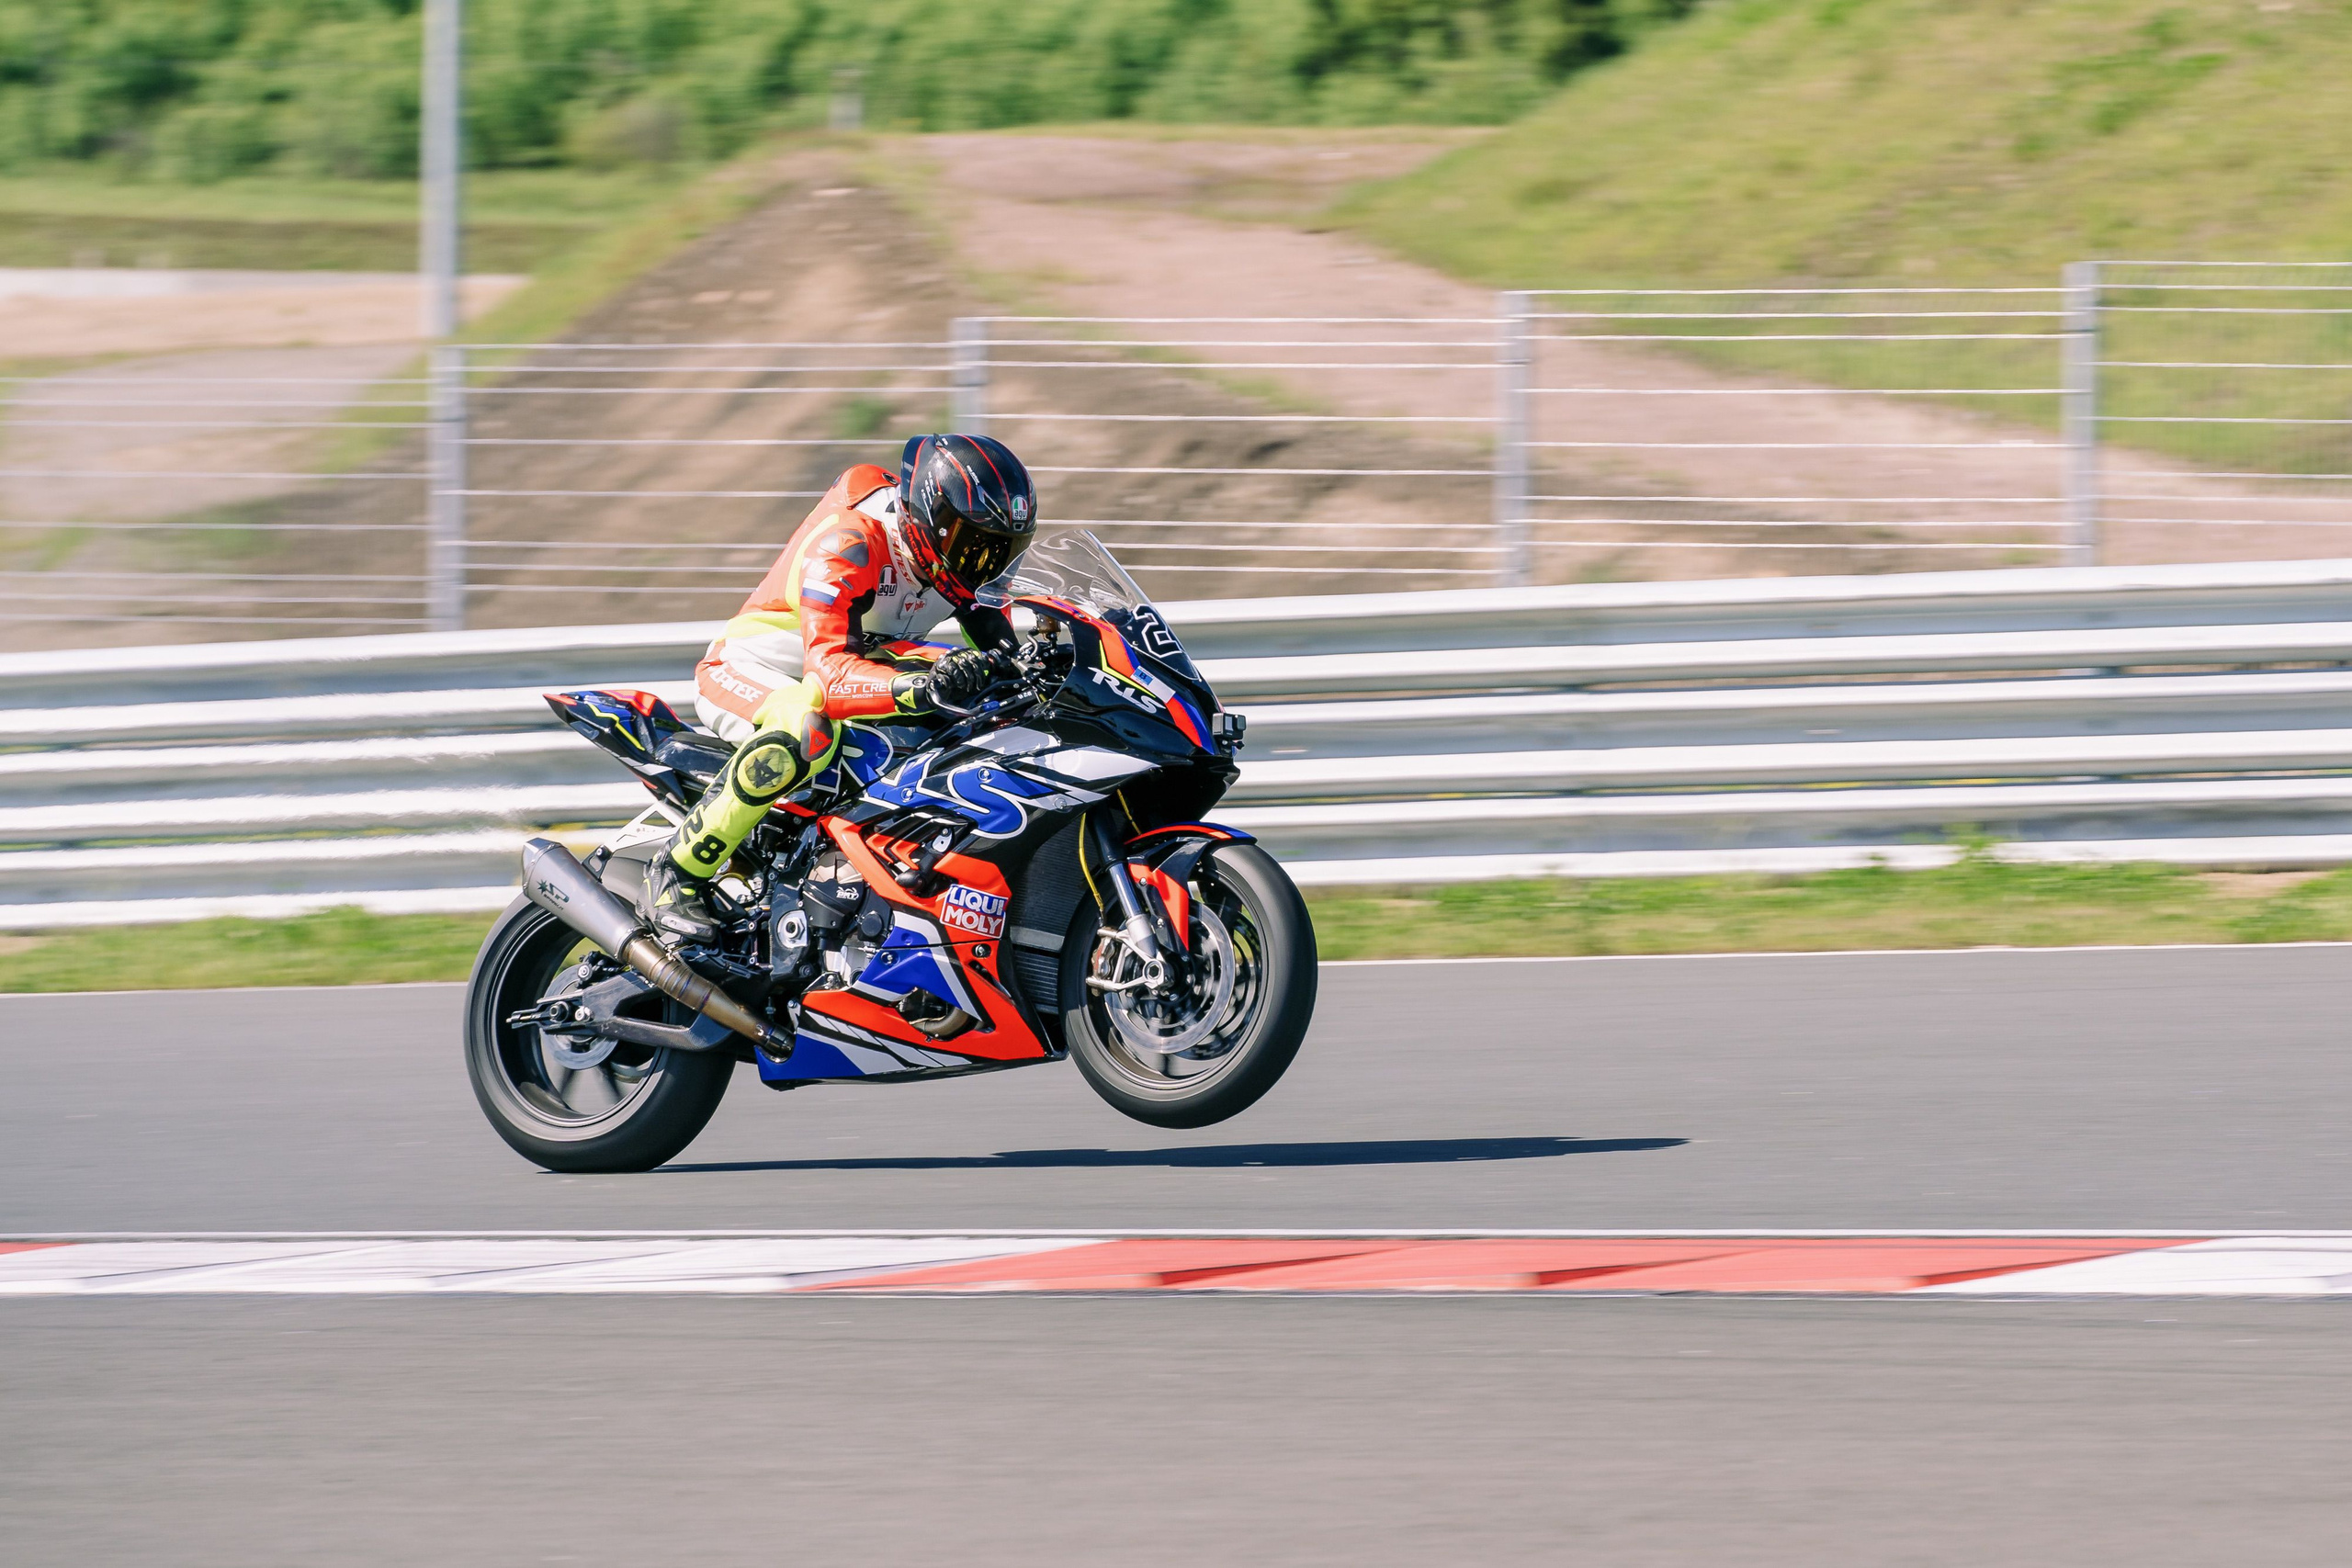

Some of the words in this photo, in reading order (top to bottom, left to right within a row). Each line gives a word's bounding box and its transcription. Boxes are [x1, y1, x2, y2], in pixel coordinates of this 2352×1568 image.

[828, 682, 860, 694] FAST
[1087, 666, 1167, 715] RLS
[683, 808, 728, 866] 28
[948, 886, 1005, 916] LIQUI
[944, 905, 1002, 935] MOLY
